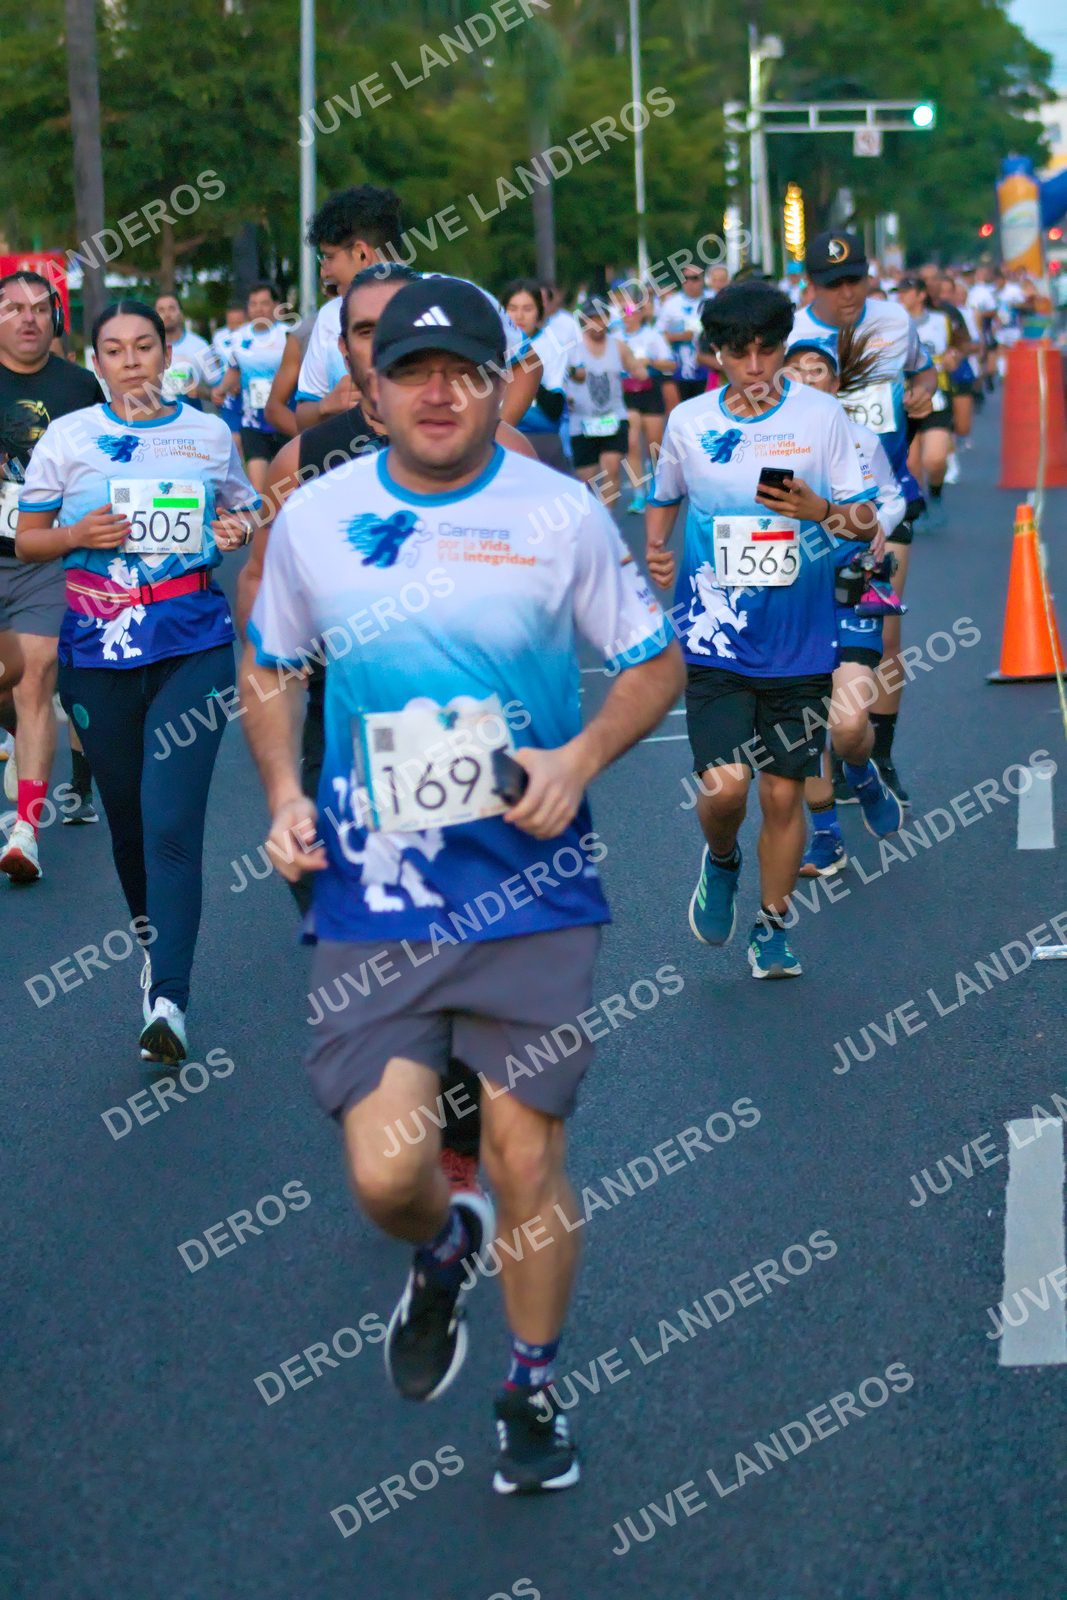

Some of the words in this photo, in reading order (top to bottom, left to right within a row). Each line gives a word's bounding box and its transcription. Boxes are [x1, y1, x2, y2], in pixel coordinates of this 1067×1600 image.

[152, 438, 195, 446] Carrera
[753, 432, 795, 442] Carrera
[777, 440, 796, 448] Vida
[768, 446, 811, 456] Integridad
[127, 510, 191, 543] 505
[438, 522, 510, 540] Carrera
[479, 540, 511, 552] Vida
[463, 552, 537, 566] Integridad
[720, 546, 797, 576] 1565
[382, 744, 508, 816] 169
